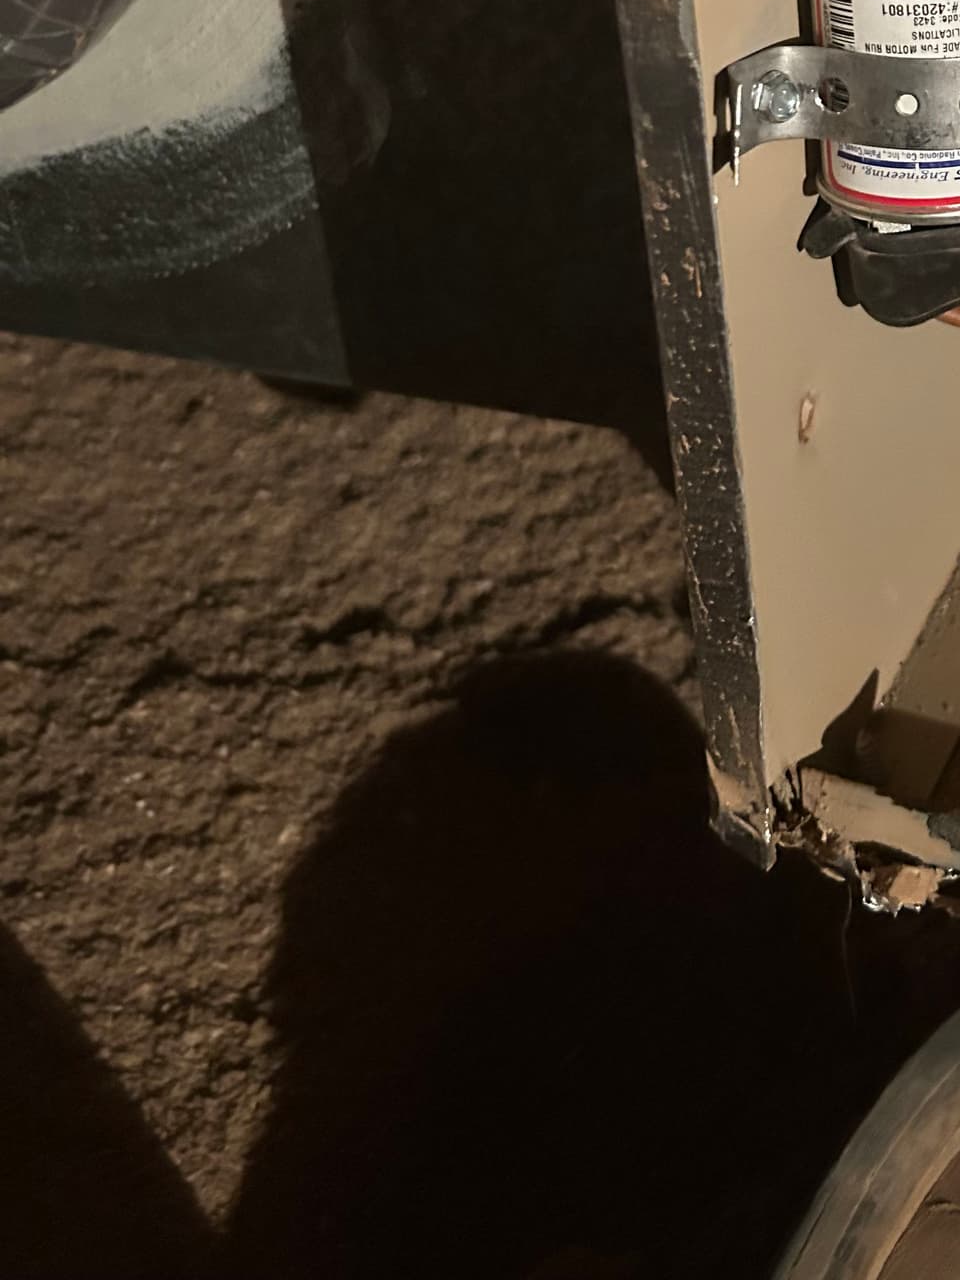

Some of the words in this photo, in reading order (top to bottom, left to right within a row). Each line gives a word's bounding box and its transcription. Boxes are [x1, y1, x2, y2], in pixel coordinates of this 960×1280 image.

[913, 16, 936, 26] 3423
[864, 43, 882, 54] RUN
[885, 44, 917, 54] MOTOR
[864, 148, 881, 158] Palm
[919, 151, 955, 159] Radionic
